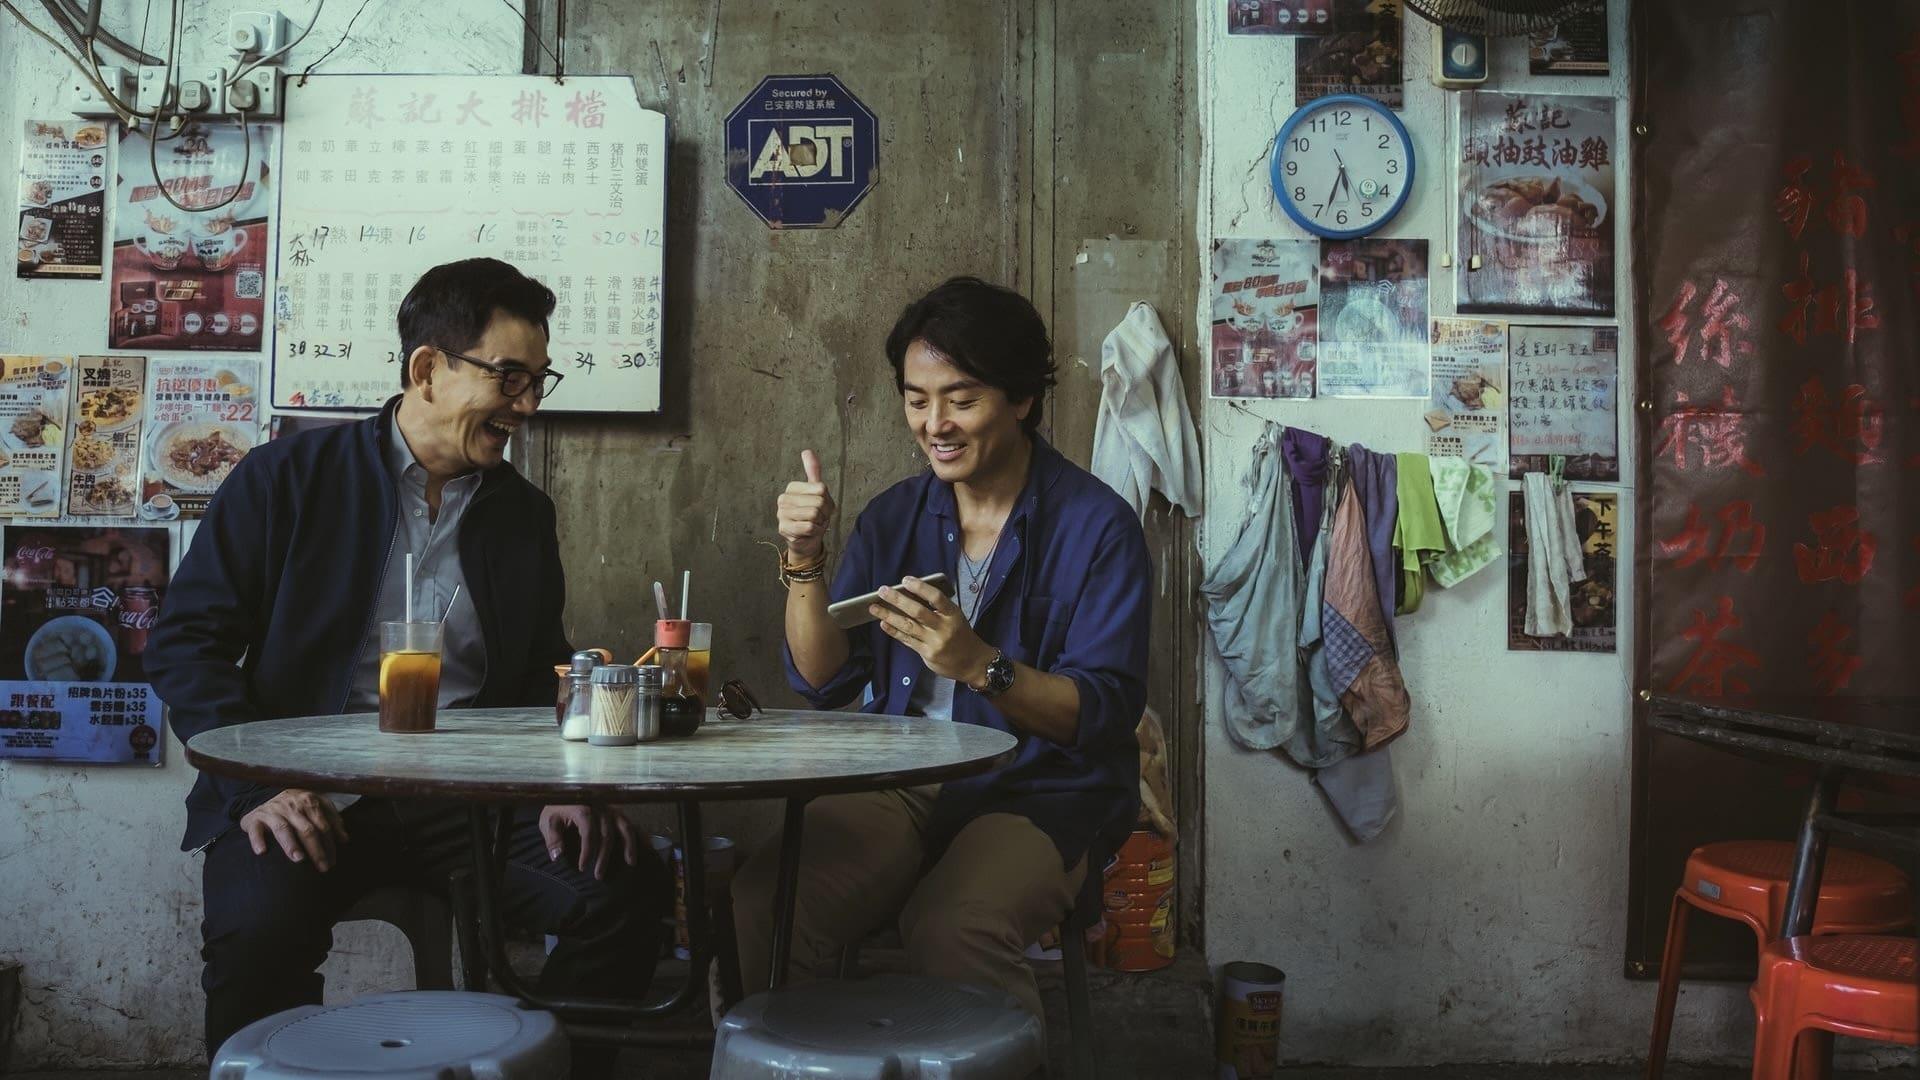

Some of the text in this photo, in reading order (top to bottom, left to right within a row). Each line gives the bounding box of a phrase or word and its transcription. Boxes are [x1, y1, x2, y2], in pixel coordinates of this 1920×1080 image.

[772, 87, 828, 101] Secured by
[1310, 118, 1326, 133] 11
[1331, 110, 1351, 126] 12
[1363, 117, 1370, 131] 1
[1291, 137, 1310, 152] 10
[1378, 134, 1390, 149] 2
[750, 125, 854, 179] ADT
[586, 142, 601, 185] 西多士
[1286, 161, 1297, 176] 9
[1386, 159, 1398, 174] 3
[1294, 186, 1305, 201] 8
[1379, 184, 1390, 197] 4
[1312, 204, 1323, 218] 7
[1335, 209, 1347, 224] 6
[1361, 202, 1373, 217] 5
[83, 367, 111, 380] 叉燒
[220, 403, 256, 422] $22
